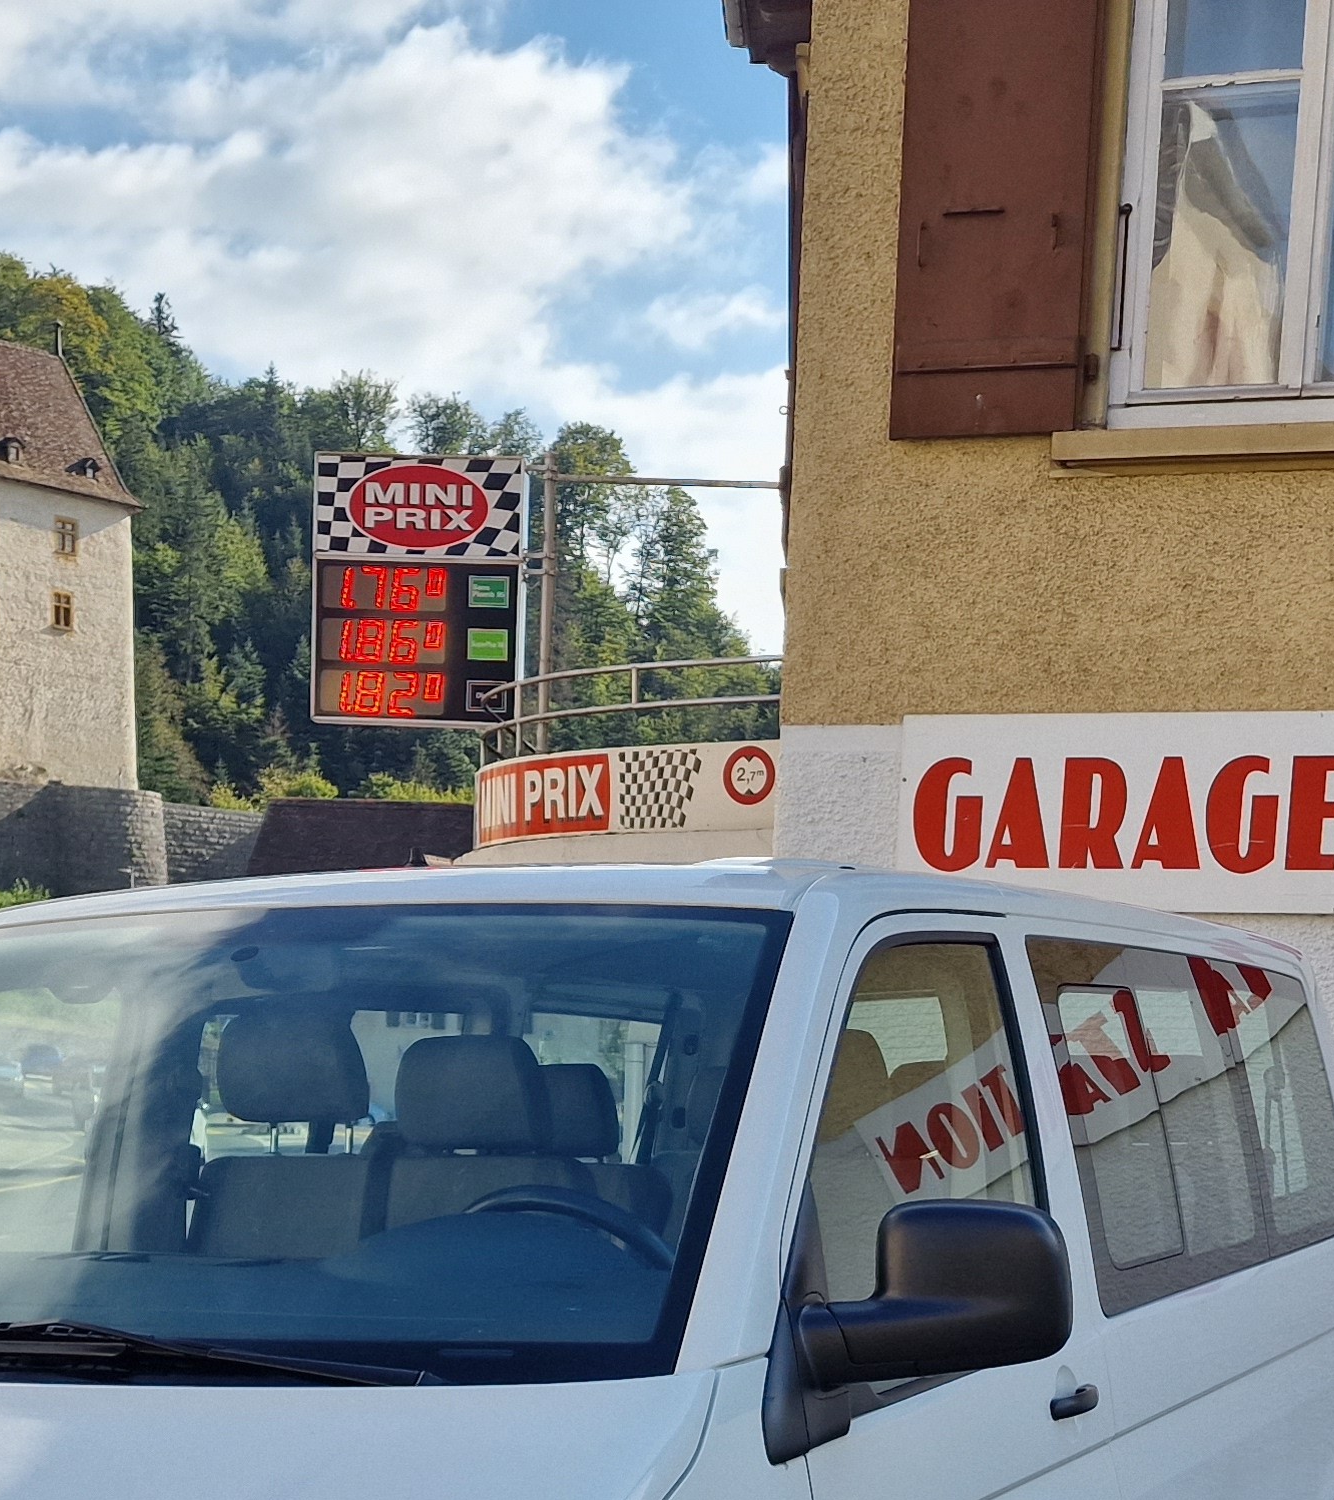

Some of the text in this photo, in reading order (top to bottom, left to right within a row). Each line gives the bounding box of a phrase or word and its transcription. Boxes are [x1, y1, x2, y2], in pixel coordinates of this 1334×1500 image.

[364, 481, 474, 507] MINI
[363, 507, 475, 532] PRIX
[480, 763, 605, 829] MINI PRIX
